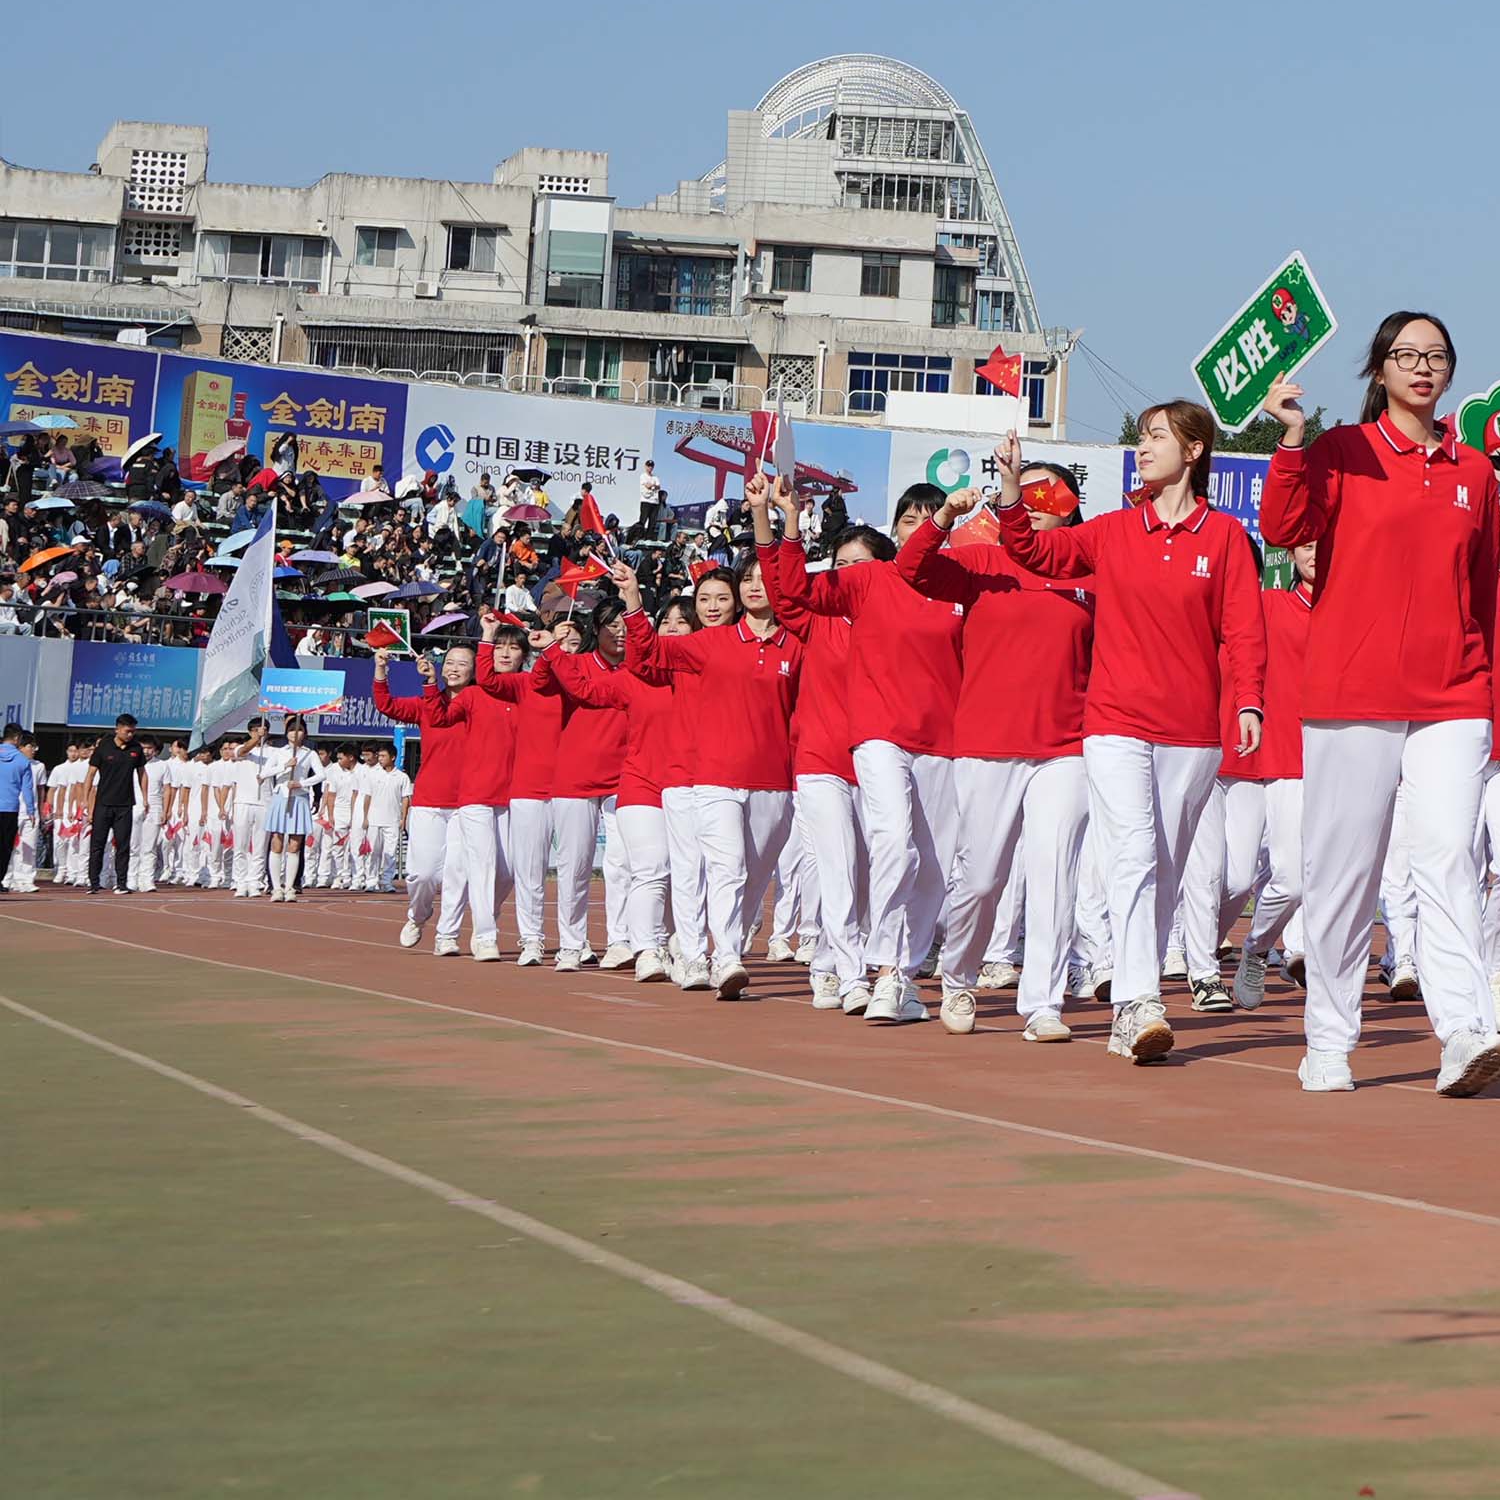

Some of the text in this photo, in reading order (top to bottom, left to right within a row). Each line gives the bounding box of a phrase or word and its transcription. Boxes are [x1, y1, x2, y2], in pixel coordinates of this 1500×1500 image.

[1212, 317, 1281, 401] 必胜
[271, 435, 377, 460] 南春集团
[465, 434, 641, 472] 中国建设银行
[464, 460, 501, 476] China
[585, 470, 617, 486] Bank
[981, 455, 1089, 487] 中寿
